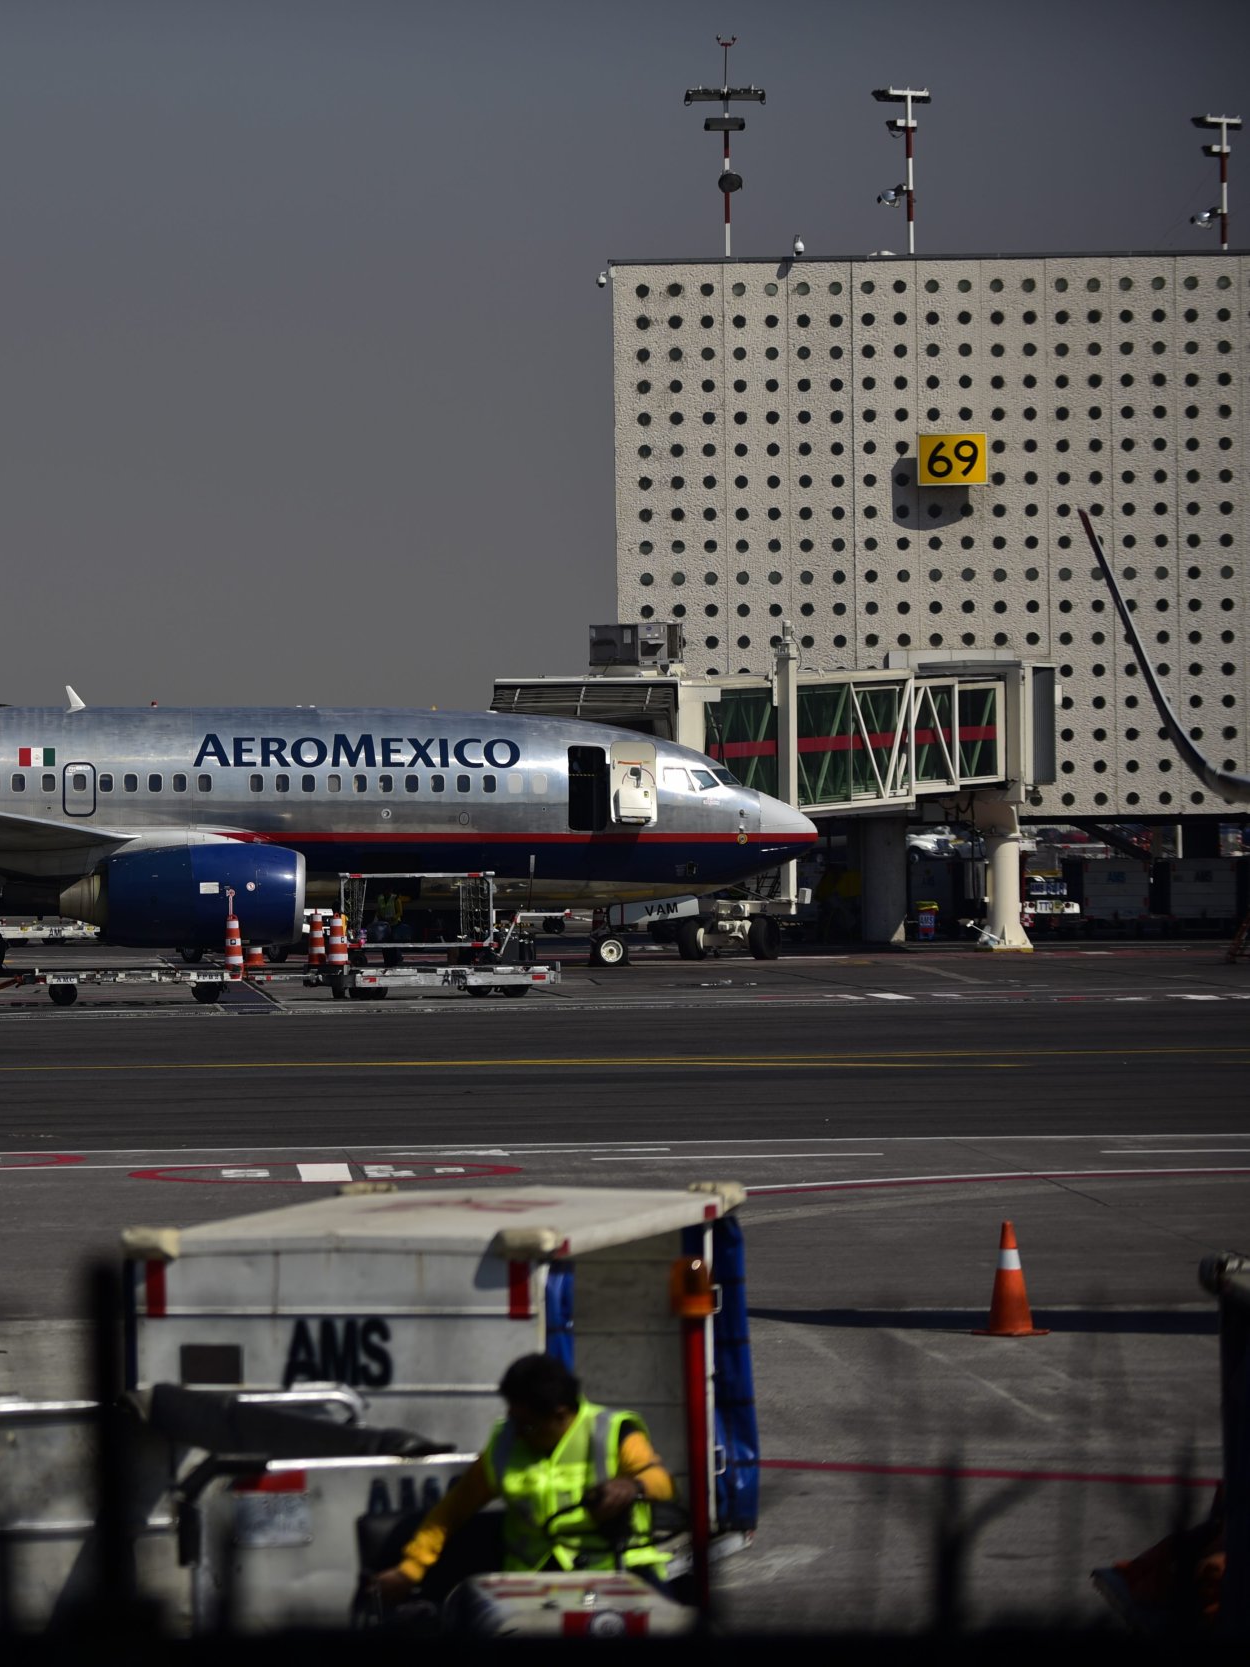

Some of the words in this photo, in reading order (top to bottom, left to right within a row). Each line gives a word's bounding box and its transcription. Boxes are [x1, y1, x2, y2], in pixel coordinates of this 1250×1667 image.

[928, 440, 978, 478] 69
[193, 733, 521, 769] AEROMEXICO
[644, 902, 679, 917] VAM
[283, 1319, 393, 1388] AMS
